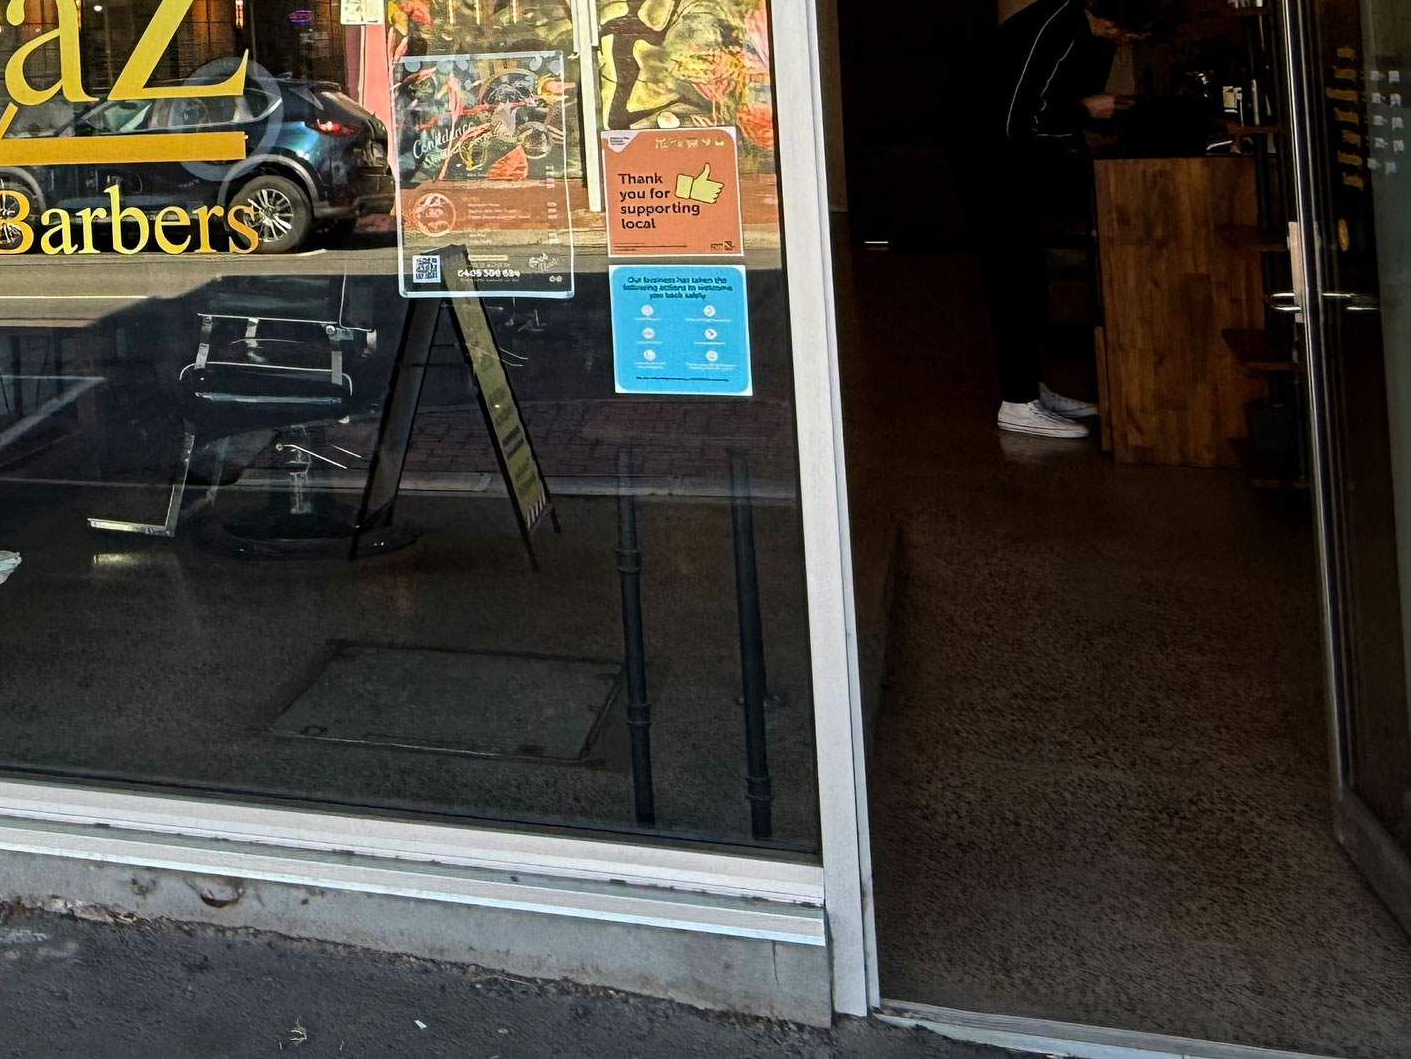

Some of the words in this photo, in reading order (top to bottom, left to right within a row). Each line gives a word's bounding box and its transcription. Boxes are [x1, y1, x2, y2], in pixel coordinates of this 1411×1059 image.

[618, 172, 664, 185] Thank
[620, 190, 646, 202] you
[650, 188, 670, 199] for
[620, 202, 701, 216] supporting
[621, 218, 656, 230] local
